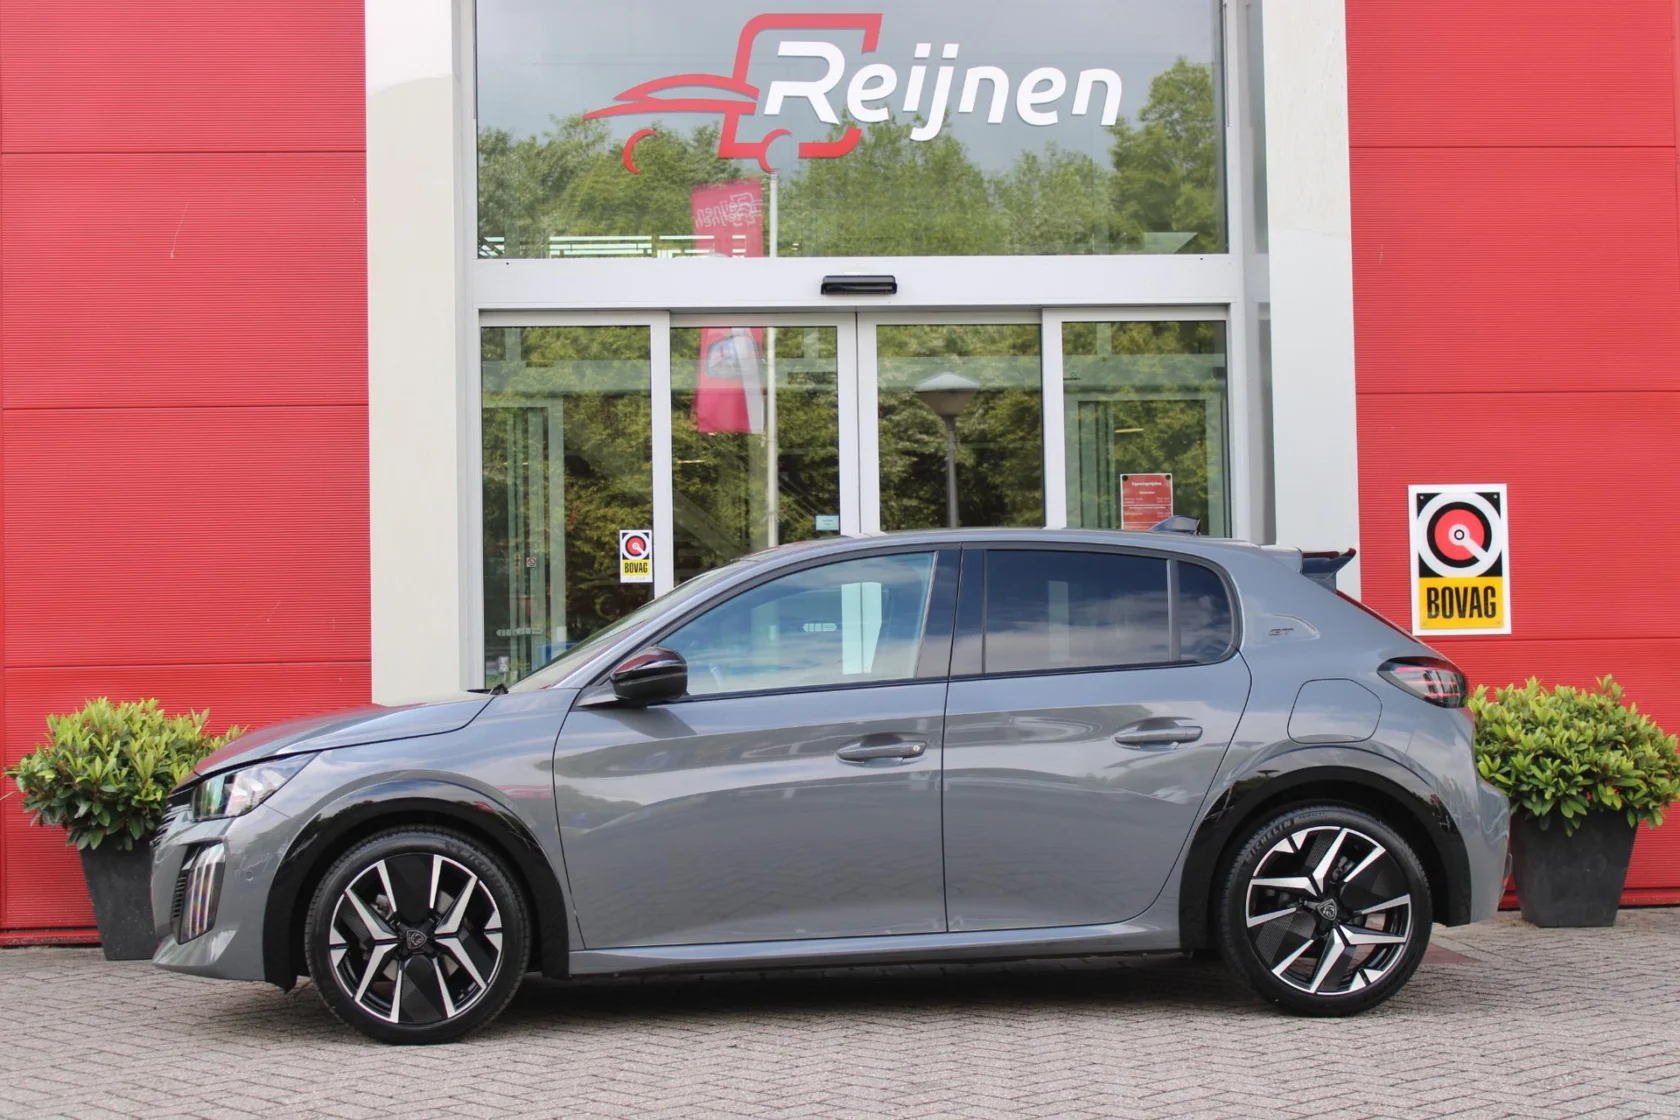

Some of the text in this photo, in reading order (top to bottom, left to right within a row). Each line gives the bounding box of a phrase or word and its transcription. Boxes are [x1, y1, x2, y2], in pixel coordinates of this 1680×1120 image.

[763, 41, 1122, 141] Reijnen
[624, 562, 648, 573] BOVAG
[1427, 586, 1496, 619] BOVAG
